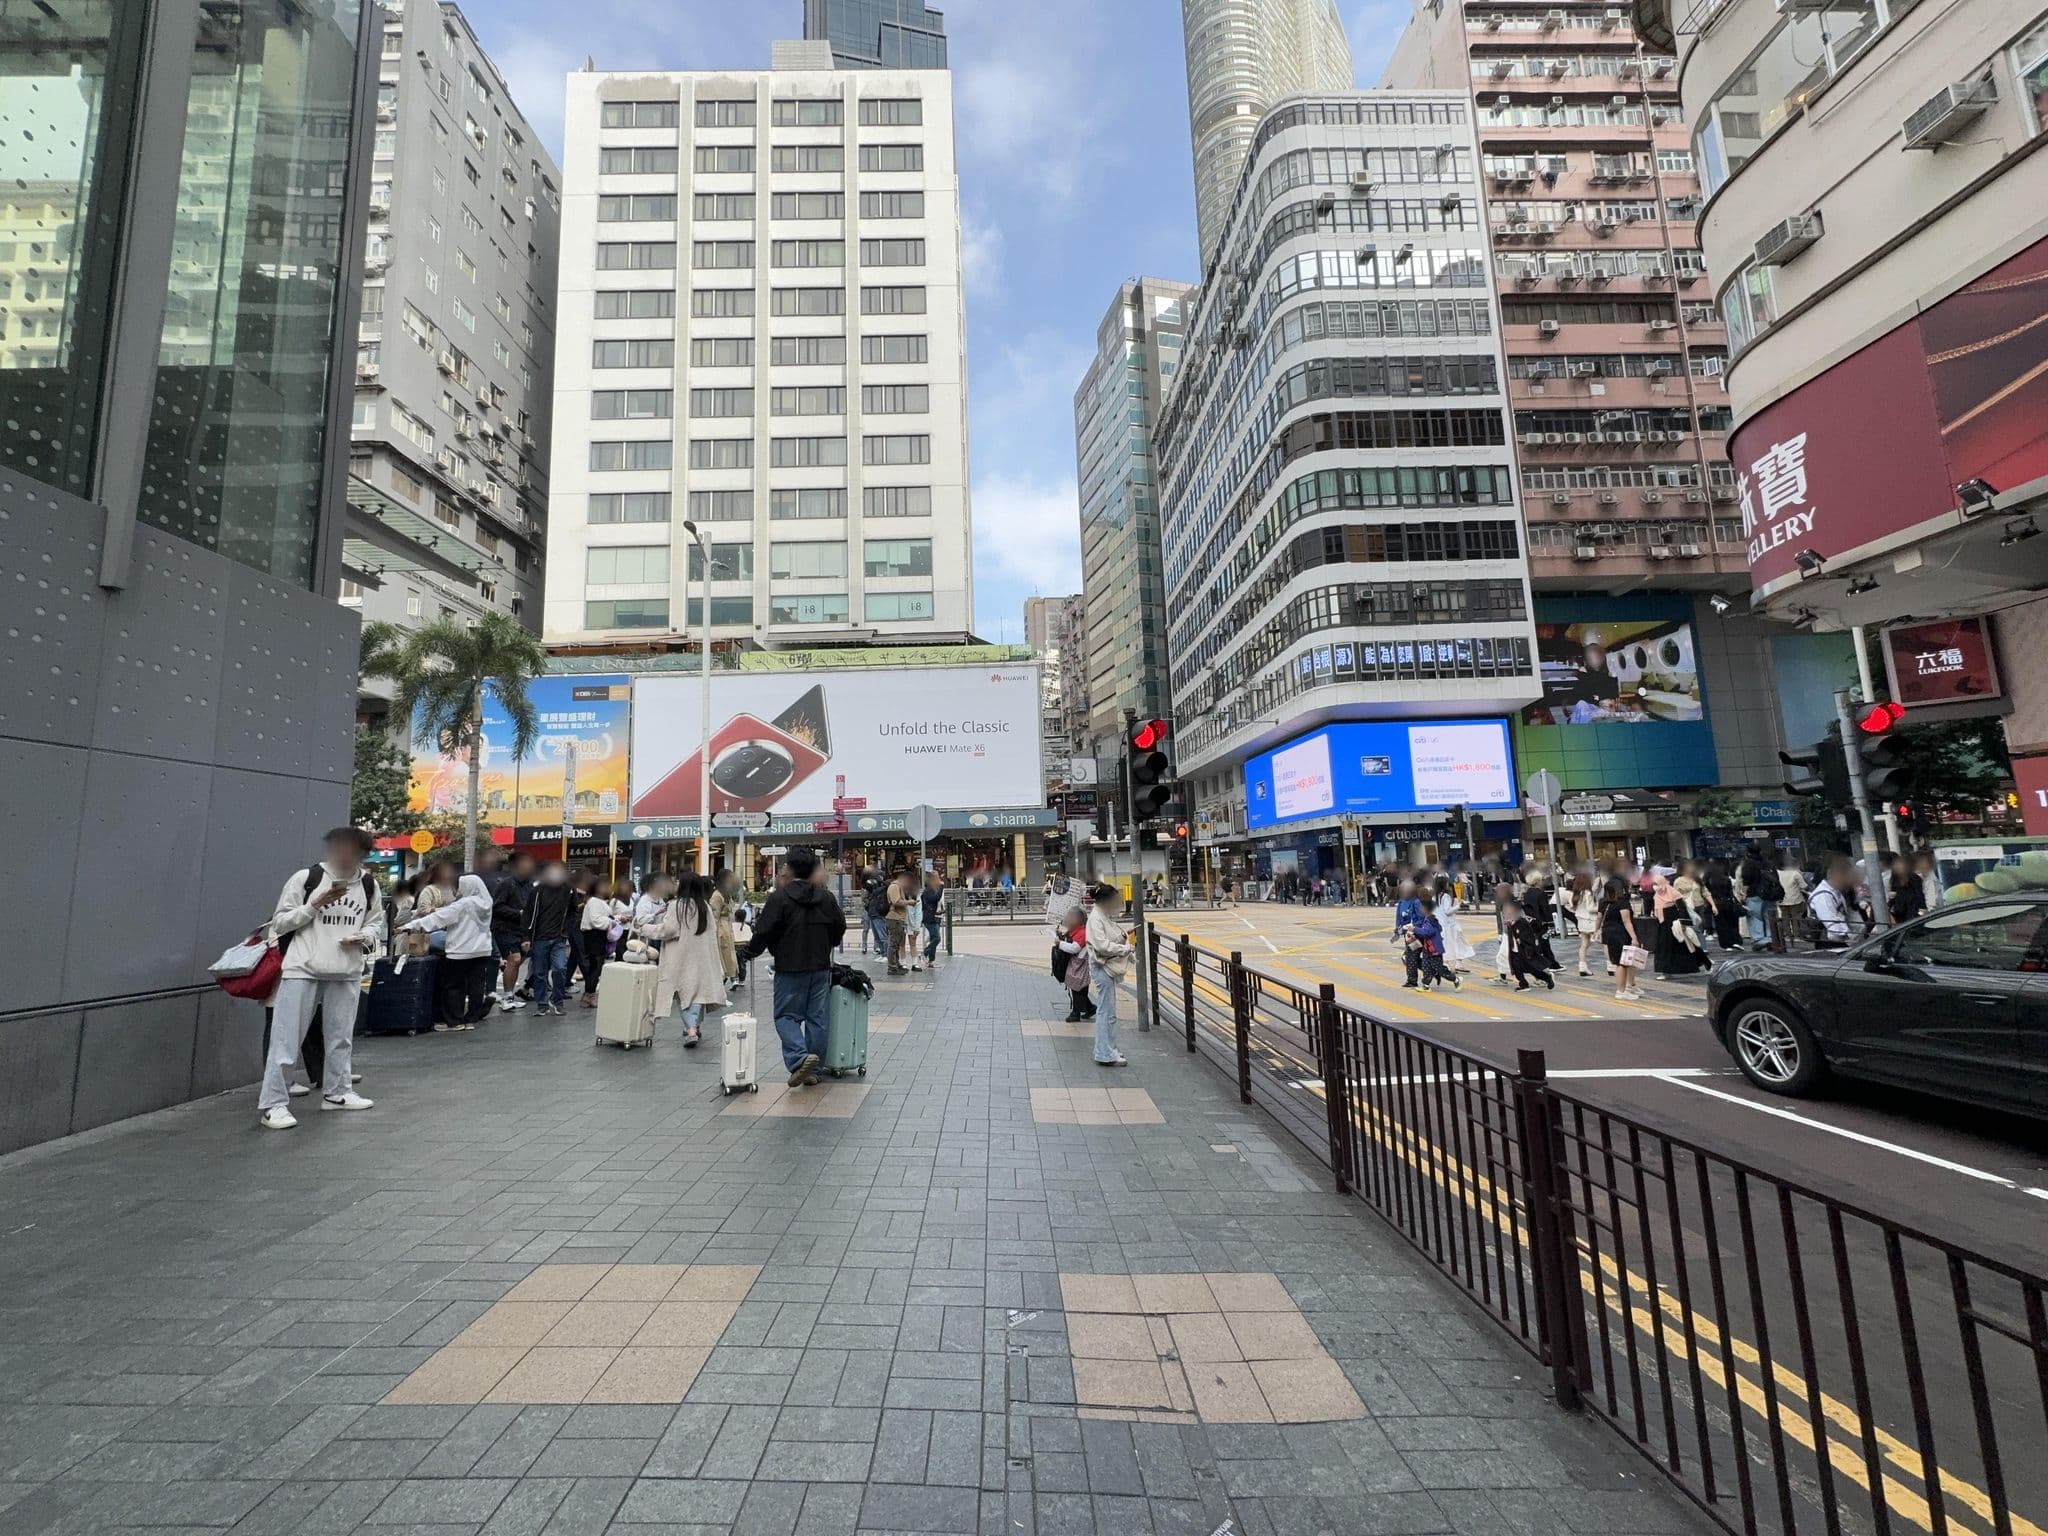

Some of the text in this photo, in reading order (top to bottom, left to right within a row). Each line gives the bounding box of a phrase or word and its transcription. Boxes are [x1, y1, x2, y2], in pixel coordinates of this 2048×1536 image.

[1915, 648, 1964, 669] 六福
[1918, 665, 1964, 675] LUKFOOK
[879, 720, 1010, 736] Unfold the Classic
[904, 744, 986, 754] HUAWEI Mate X6
[770, 815, 814, 833] shama
[881, 817, 905, 829] sha
[992, 813, 1036, 826] shama
[573, 828, 593, 838] DBS
[1385, 829, 1431, 841] citibank
[864, 839, 919, 848] GIORDANO
[604, 845, 624, 855] DS
[322, 915, 341, 926] ONLY
